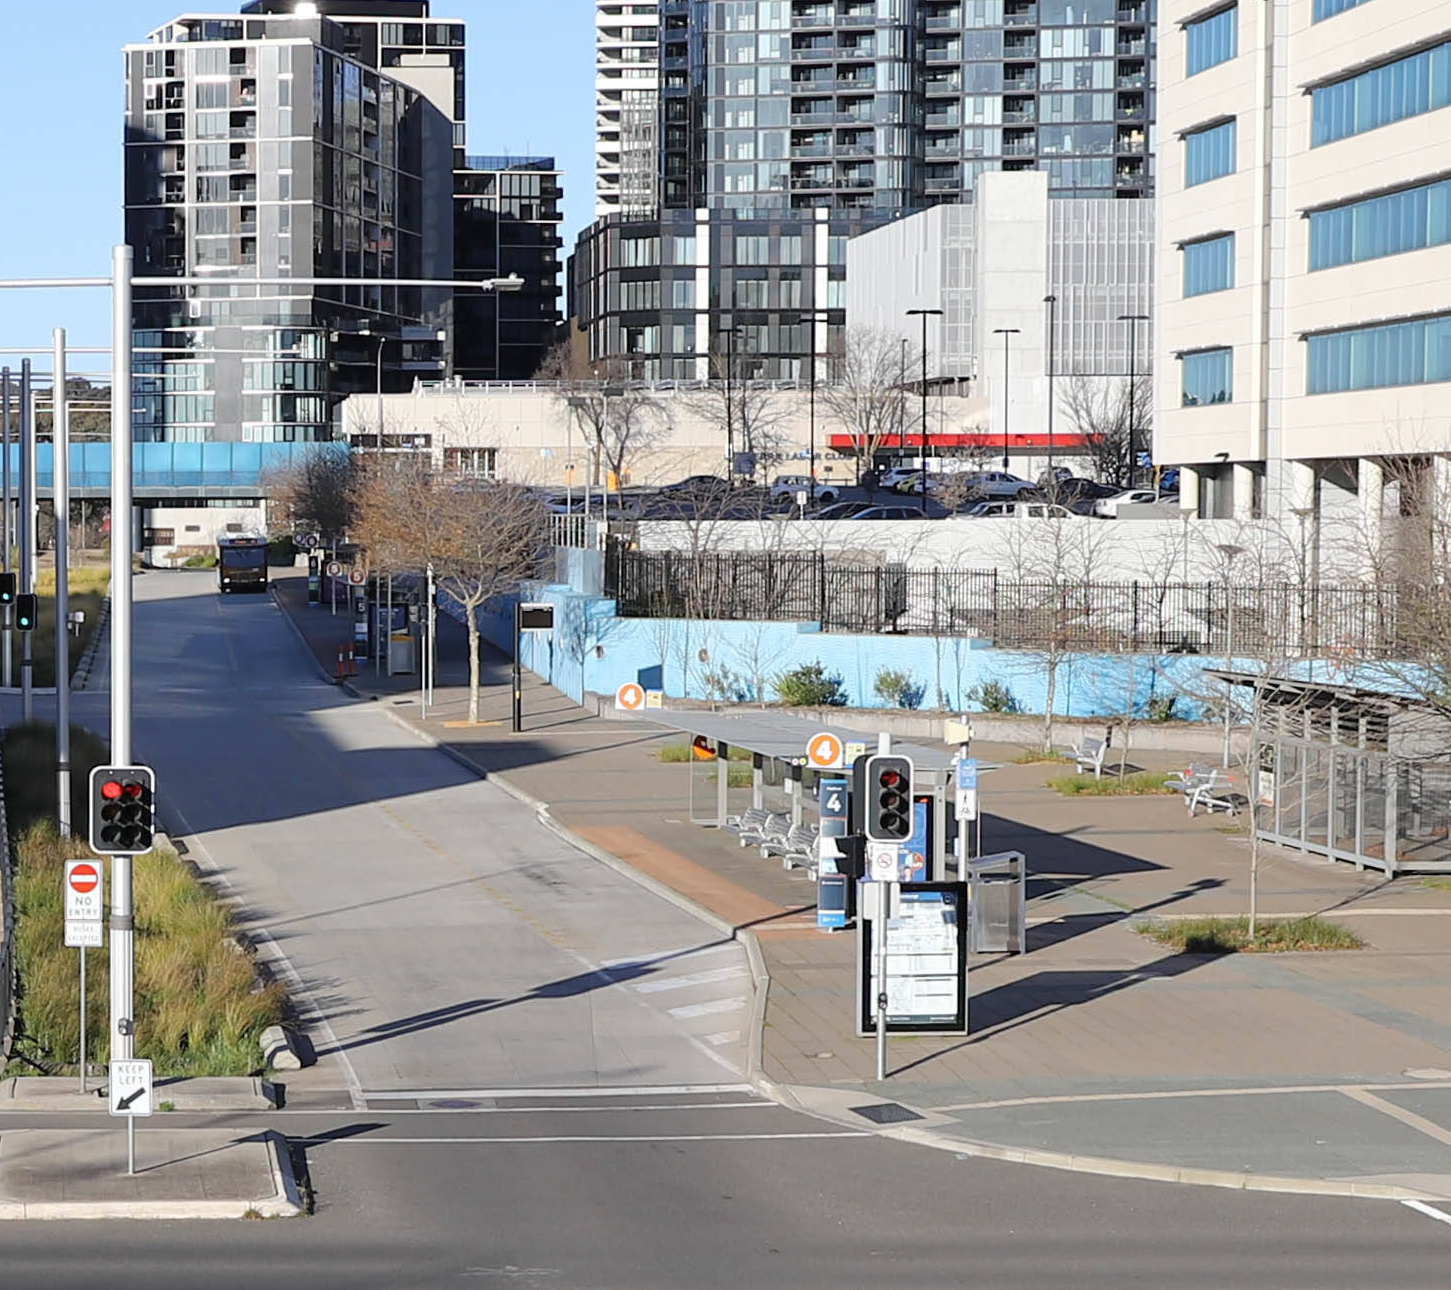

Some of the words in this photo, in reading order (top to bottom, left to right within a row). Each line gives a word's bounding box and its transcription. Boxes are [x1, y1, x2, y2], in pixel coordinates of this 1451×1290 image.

[624, 688, 636, 705] 4
[816, 740, 833, 760] 4
[826, 793, 842, 813] 4
[75, 896, 92, 906] NO
[68, 908, 98, 917] ENTRY
[118, 1064, 145, 1074] KEEP
[118, 1075, 144, 1085] LEFT
